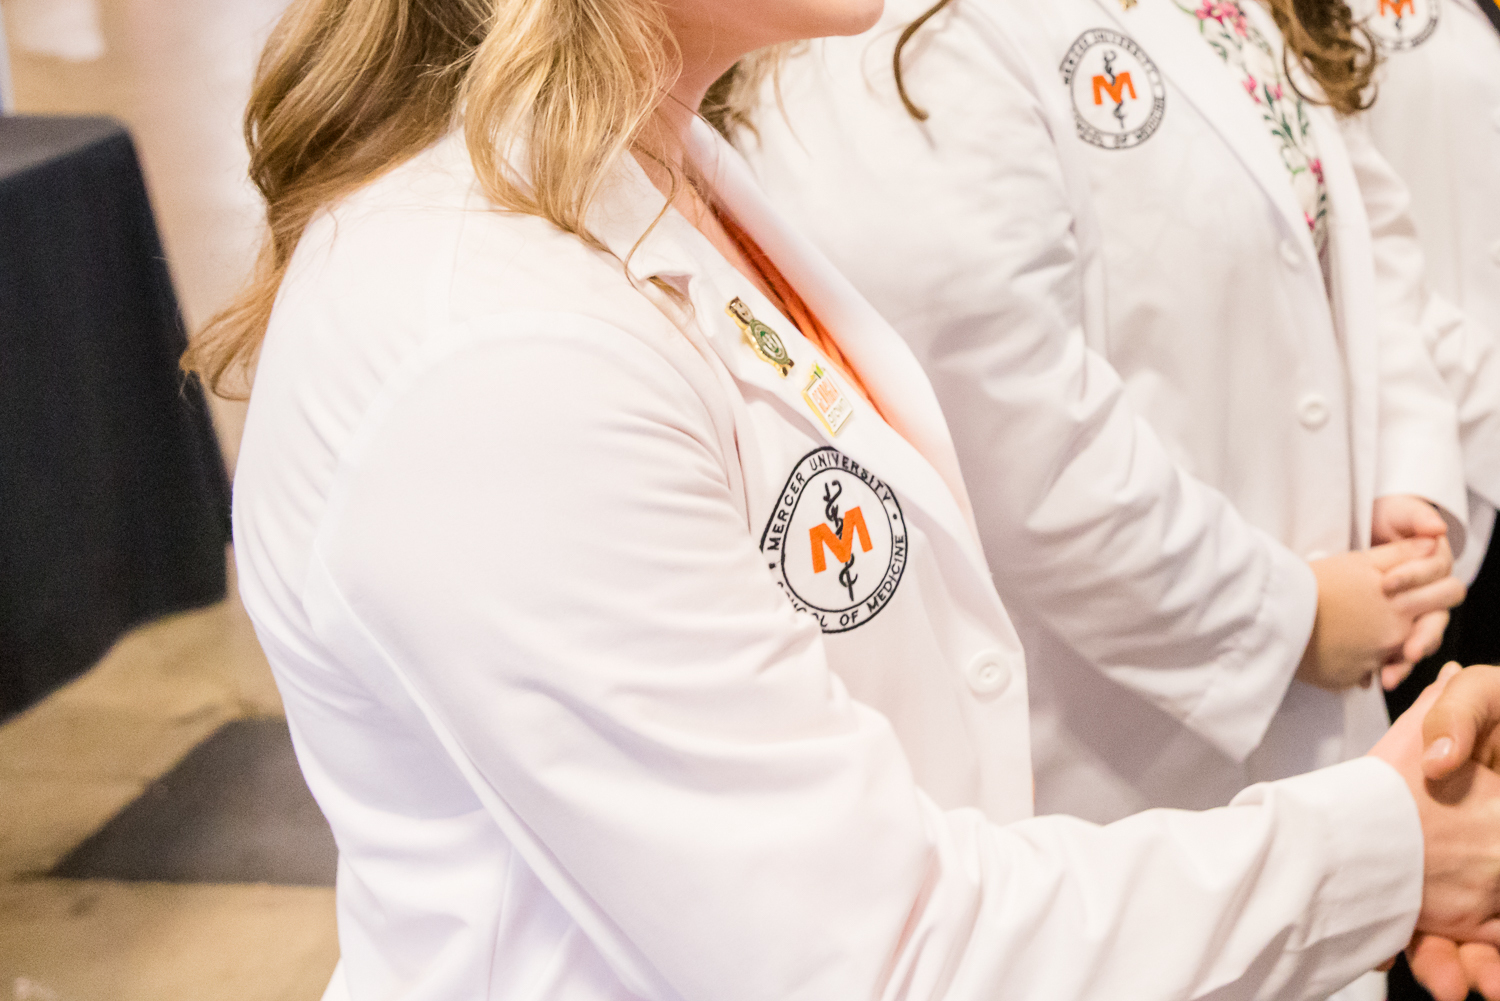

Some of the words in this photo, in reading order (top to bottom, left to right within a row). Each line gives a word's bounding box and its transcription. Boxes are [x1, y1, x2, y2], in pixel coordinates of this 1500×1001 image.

[1092, 72, 1137, 105] M
[767, 472, 805, 551] MERCER
[809, 453, 892, 501] UNIVERSITY
[808, 505, 873, 574] M
[839, 609, 859, 627] OF
[866, 534, 904, 613] MEDICINE
